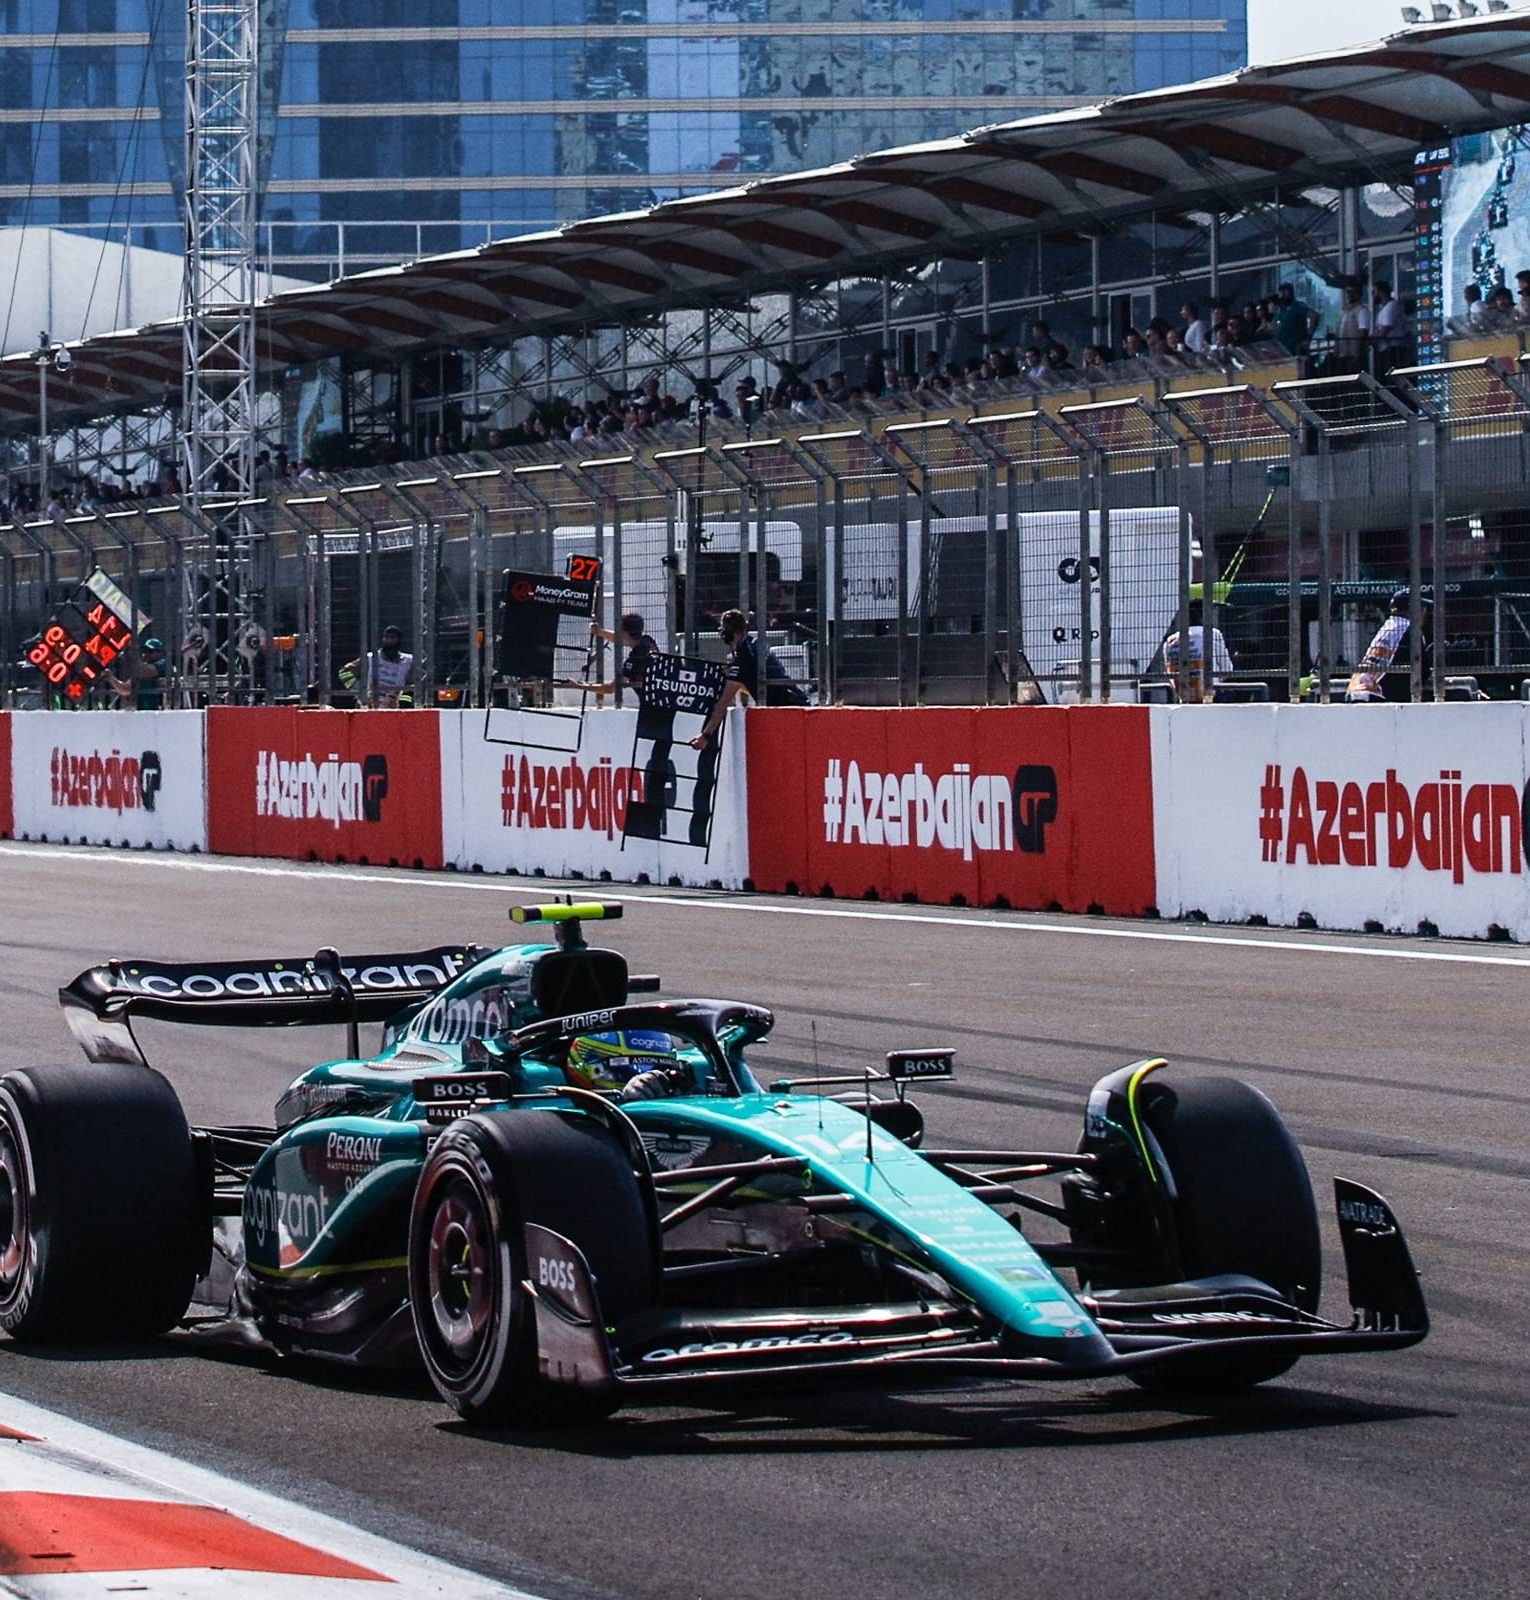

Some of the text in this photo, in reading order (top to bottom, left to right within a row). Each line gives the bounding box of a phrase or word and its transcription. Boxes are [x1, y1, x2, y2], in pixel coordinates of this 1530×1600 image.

[570, 558, 599, 581] 27
[535, 584, 589, 600] MoneyGram
[1334, 584, 1369, 596] ASTON
[655, 677, 716, 699] TSUNODA
[904, 1058, 947, 1074] BOSS
[433, 1082, 488, 1097] BOSS
[327, 1131, 383, 1162] PERONI
[244, 1176, 335, 1248] ognizant
[538, 1256, 576, 1292] BOSS
